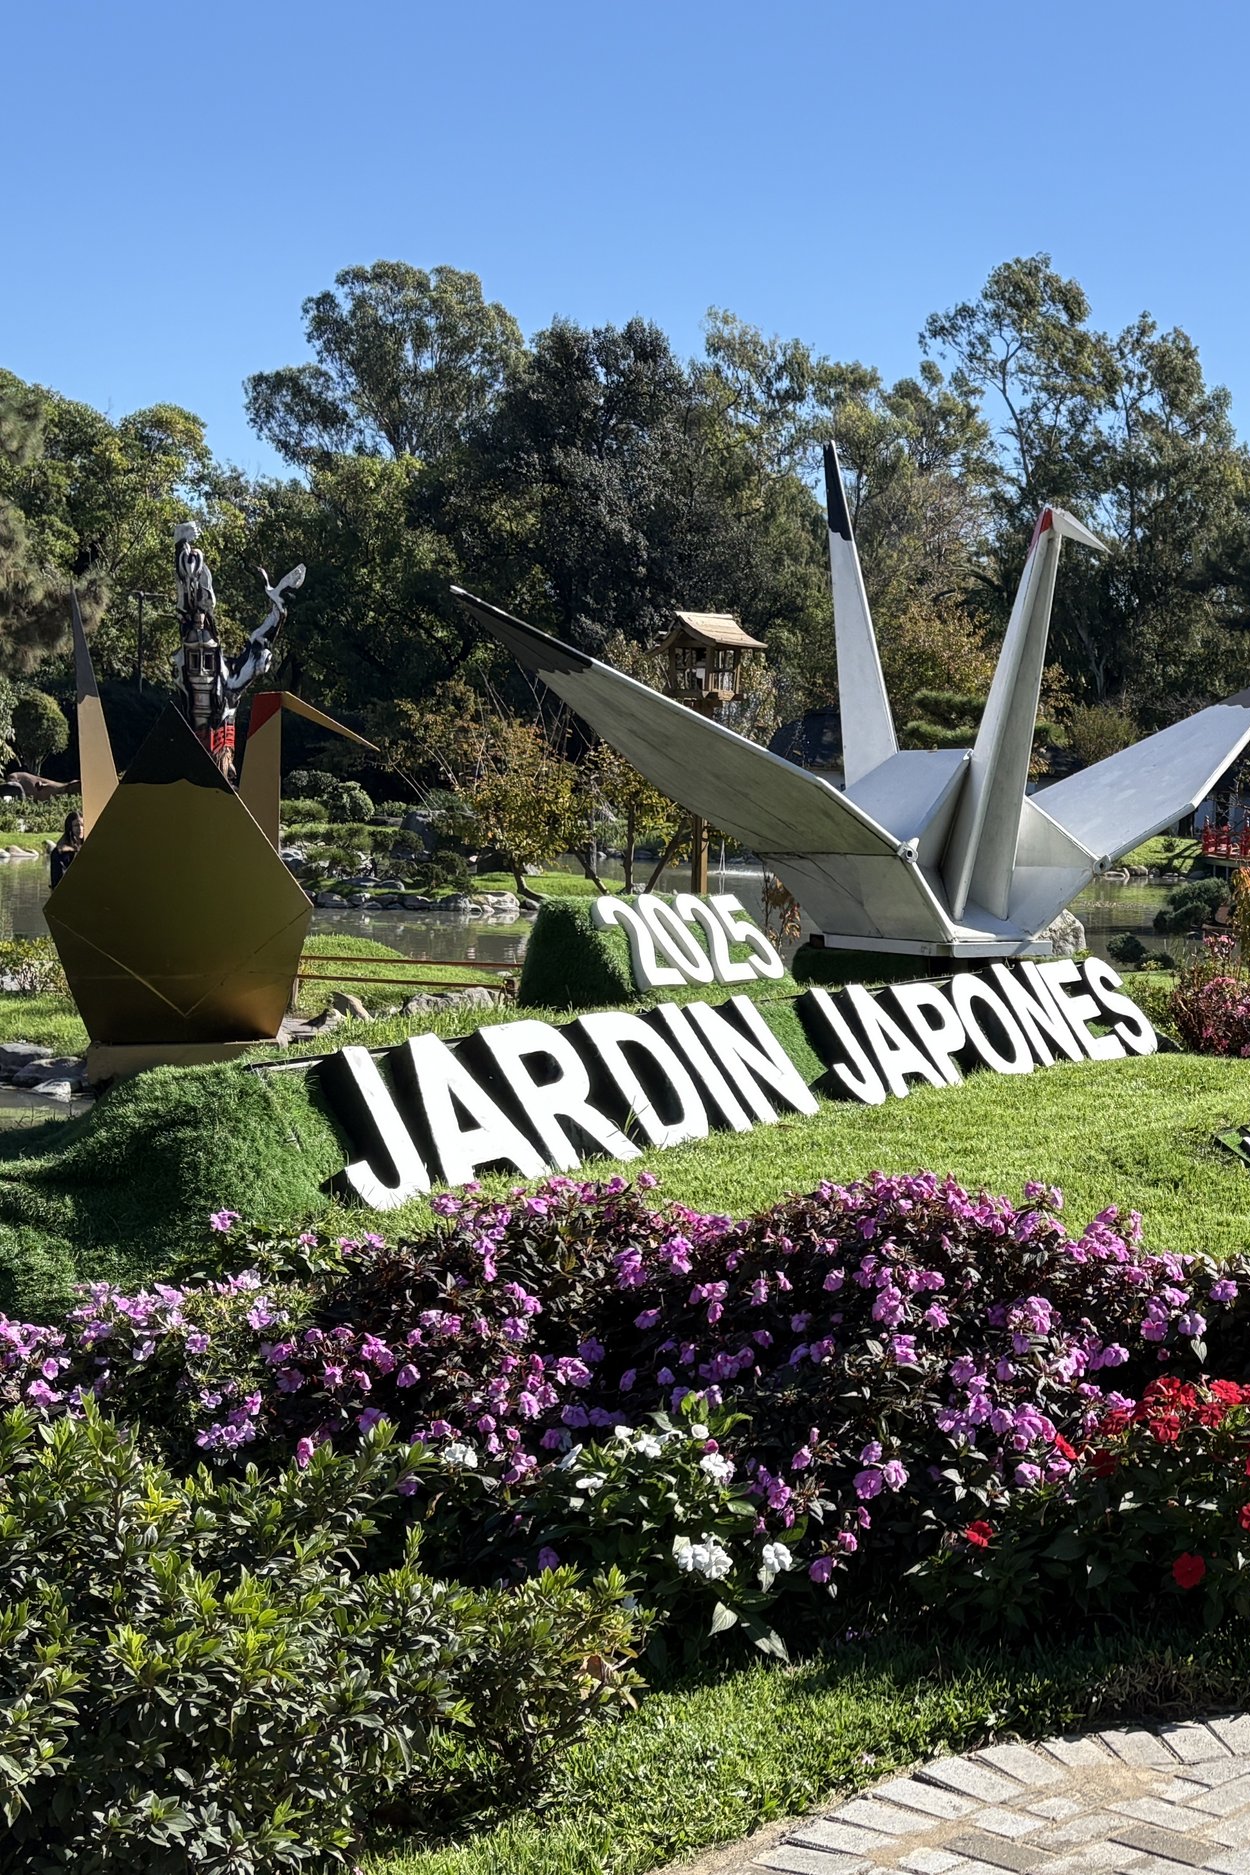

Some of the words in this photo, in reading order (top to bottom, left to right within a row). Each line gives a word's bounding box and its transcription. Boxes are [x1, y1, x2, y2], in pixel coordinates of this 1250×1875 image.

[593, 893, 785, 987] 2025
[343, 996, 819, 1211] JARDIN
[810, 957, 1158, 1106] JAPONES
